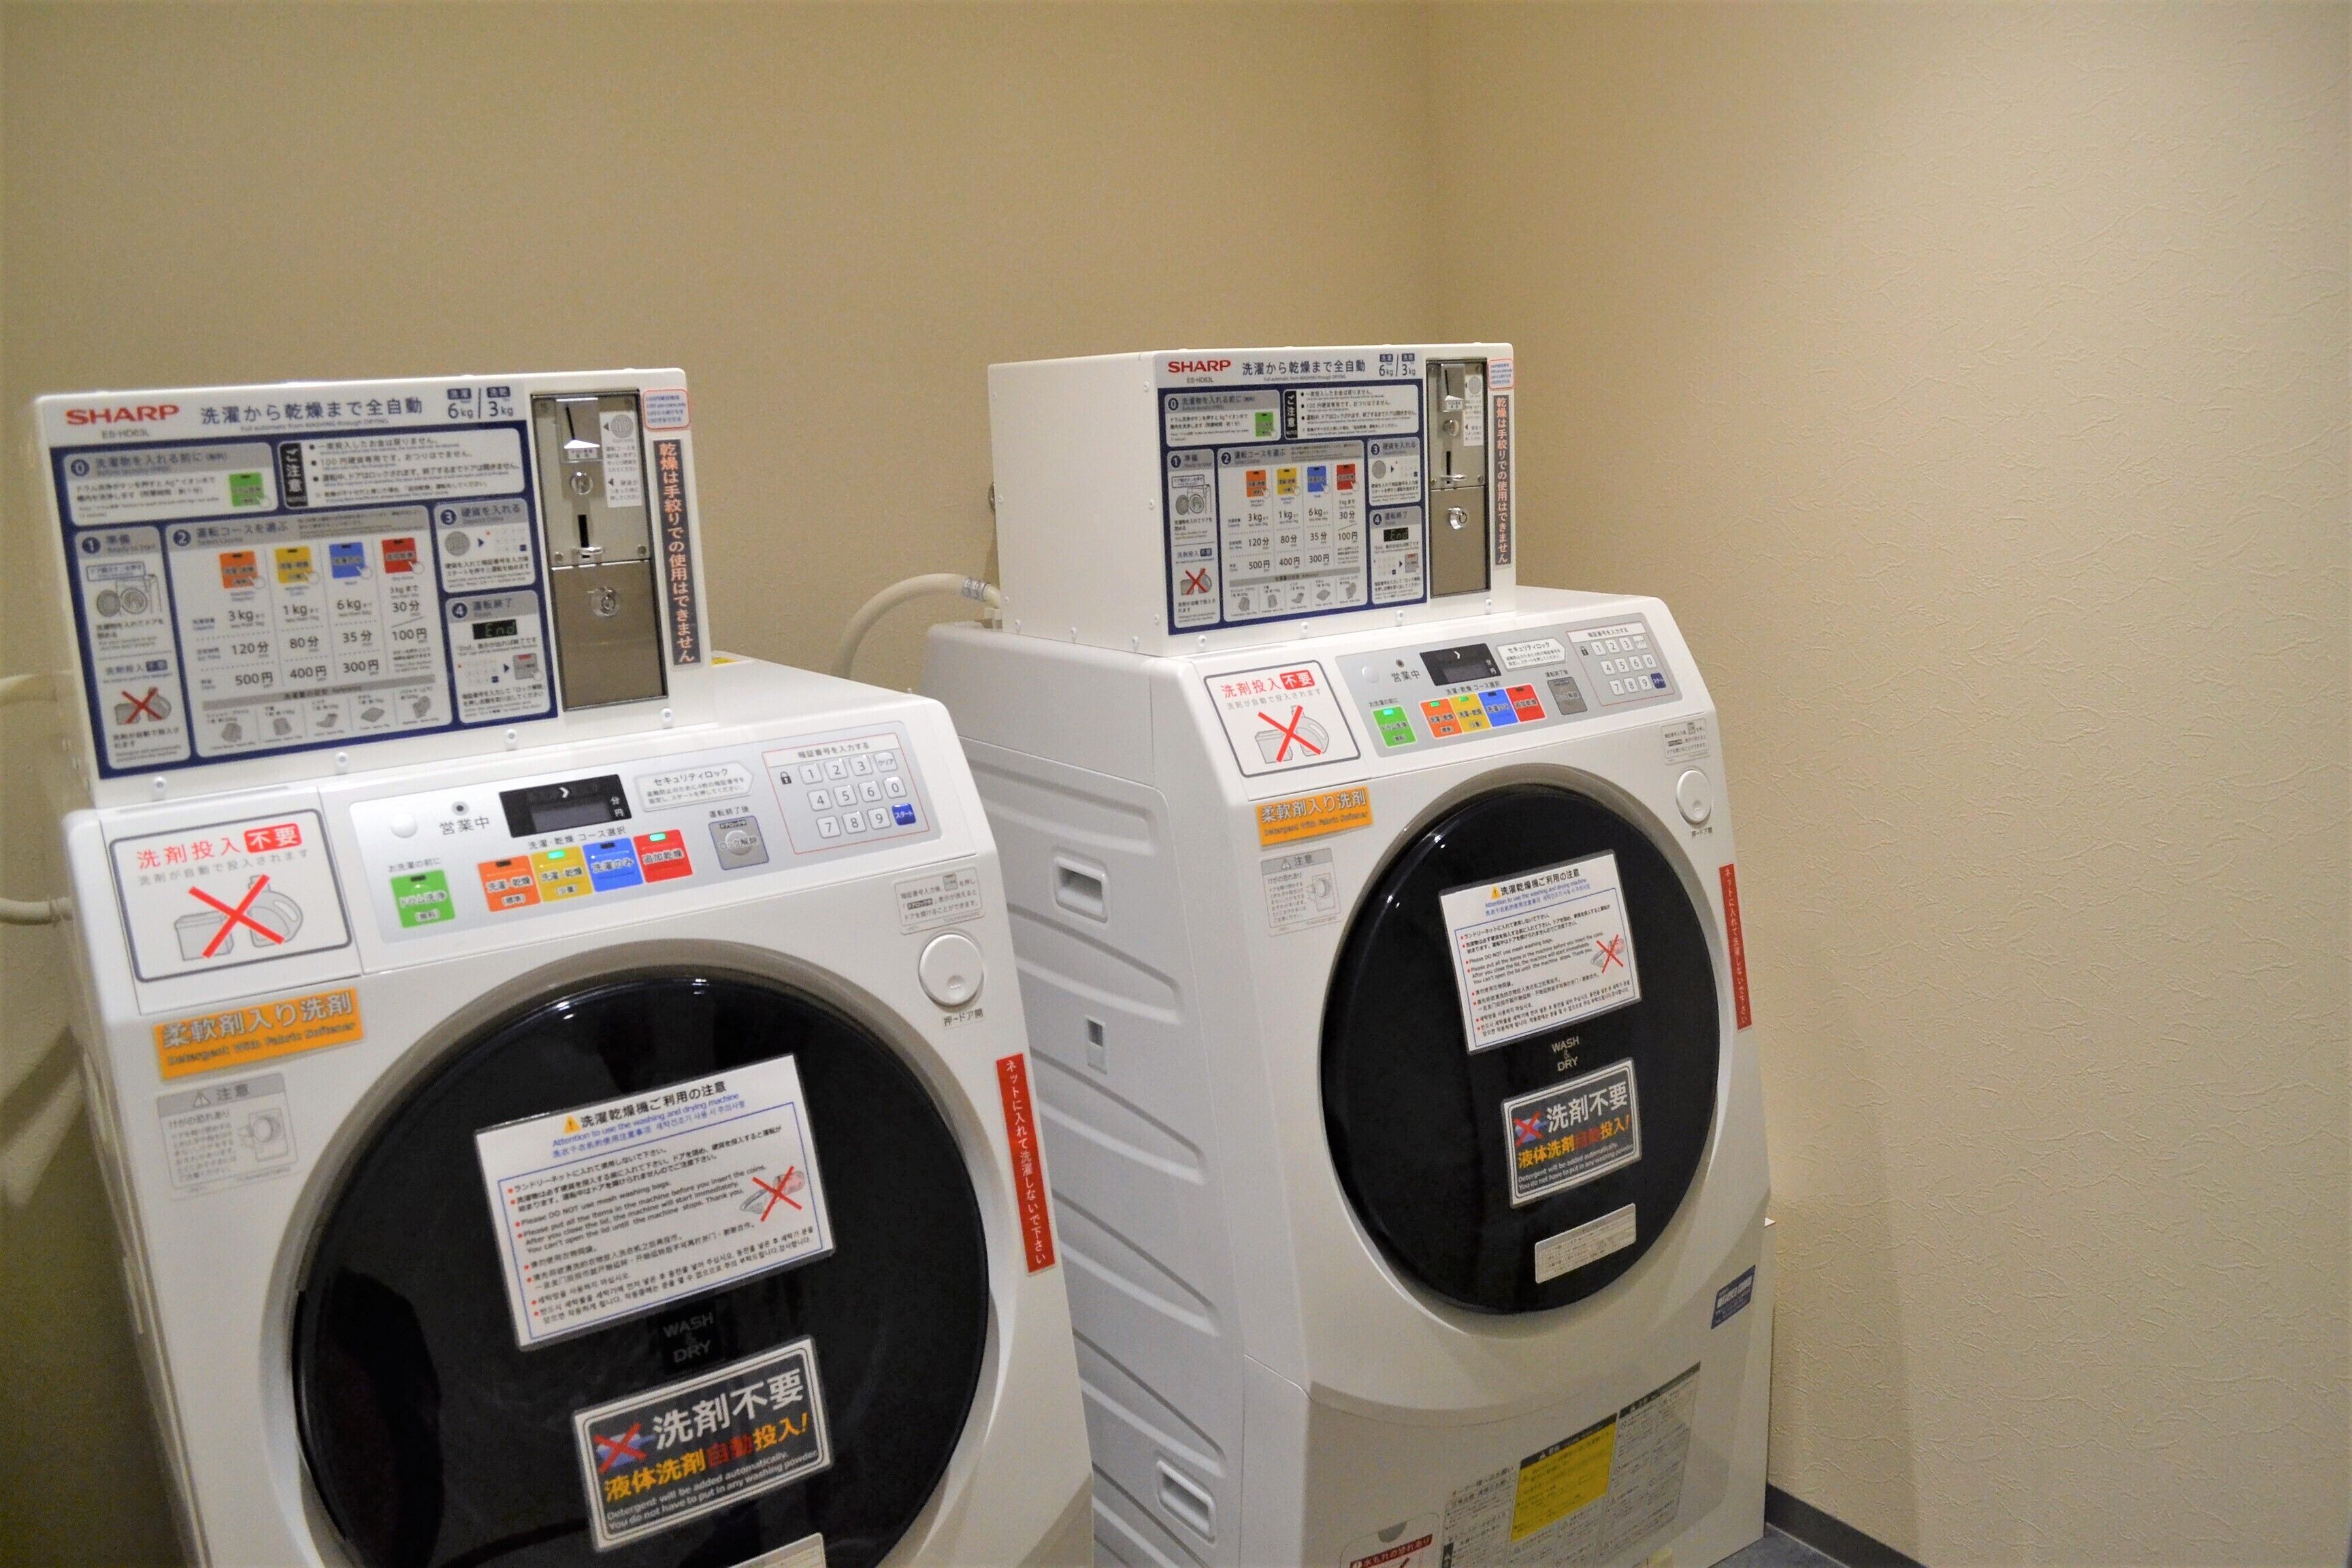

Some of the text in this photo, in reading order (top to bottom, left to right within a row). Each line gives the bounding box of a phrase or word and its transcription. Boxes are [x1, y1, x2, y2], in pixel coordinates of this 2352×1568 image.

[1168, 360, 1230, 373] SHARP
[1242, 359, 1366, 376] 洗濯から乾燥まで全自動
[65, 404, 179, 425] SHARP
[201, 397, 423, 425] 洗濯から乾燥まで全自動
[1497, 397, 1509, 564] 乾燥は手絞りでの使用はできません
[1248, 536, 1269, 547] 120分
[1280, 534, 1297, 544] 80分
[1338, 531, 1358, 541] 100円
[658, 443, 695, 664] 乾燥は手絞りでの使用はできません
[1279, 556, 1301, 566] 400円
[1309, 553, 1330, 564] 300円
[1249, 559, 1270, 570] 500円
[393, 600, 420, 613] 30分
[392, 627, 427, 642] 100円
[1587, 627, 1629, 638] 暗証番号を入力する
[231, 640, 269, 655] 120分
[289, 636, 318, 649] 80分
[1507, 642, 1550, 653] セキュリティロック
[289, 664, 327, 680] 400円
[343, 659, 379, 674] 300円
[235, 671, 273, 687] 500円
[1220, 672, 1314, 698] 洗剤投入 不要
[1391, 670, 1420, 683] 営業中
[1227, 688, 1322, 710] 洗剤が自動で投入されます
[1369, 698, 1399, 707] お洗濯の前に
[797, 741, 870, 760] 暗証番号を入力する
[832, 764, 840, 775] 2
[858, 760, 866, 772] 3
[876, 757, 894, 769] クリア
[652, 766, 729, 787] セキュリティロック
[808, 768, 815, 779] 1
[842, 790, 850, 802] 5
[866, 786, 875, 797] 6
[891, 783, 900, 794] 0
[610, 795, 621, 806] 分
[816, 795, 825, 806] 4
[1261, 788, 1367, 823] 柔軟剤入り洗剤
[614, 807, 625, 819] 円
[708, 805, 749, 819] 運転終了後
[875, 813, 883, 824] 9
[894, 809, 913, 819] スタート
[438, 815, 490, 835] 営業中
[826, 821, 833, 833] 7
[850, 817, 858, 828] 8
[577, 826, 627, 842] コース選択
[137, 825, 299, 870] 洗剤投入 不要
[718, 835, 759, 851] ロック解除
[387, 856, 442, 873] お洗濯の前に
[591, 856, 634, 873] 洗濯のみ
[642, 848, 684, 865] 追加乾燥
[1293, 853, 1313, 866] 注意
[138, 848, 308, 886] 洗剤が自動で投入されます
[1500, 868, 1580, 896] 洗濯乾燥機ご利用の注意
[399, 890, 447, 907] ドラム洗浄
[1484, 877, 1586, 909] Attention washing machine
[1468, 956, 1484, 964] Please
[1524, 941, 1541, 950] washing
[1725, 868, 1748, 1026] ネットに入れて洗濯しないで下さい
[163, 991, 353, 1048] 柔軟剤入り洗剤
[1551, 1036, 1580, 1053] WASH
[1556, 1056, 1579, 1073] DRY
[216, 1083, 249, 1101] 注意
[580, 1080, 728, 1128] 洗濯乾燥機ご利用の注意
[1546, 1081, 1628, 1133] 洗剤不要
[552, 1091, 739, 1147] Attention the washing and drying machine
[1006, 1060, 1046, 1266] ネットに入れて洗濯しないで下さい
[520, 1186, 651, 1226] Please DO NOT mesh washing
[523, 1164, 766, 1237] Please put the items the machine before insert the coins.
[525, 1194, 692, 1245] After close the the machine will start
[527, 1192, 728, 1254] You open the until the machine Thank
[662, 1311, 715, 1339] WASH
[673, 1339, 713, 1363] DRY
[653, 1368, 804, 1450] 洗剤不要
[604, 1411, 809, 1503] 液体洗剤自動投入!
[660, 1463, 783, 1513] have washing
[605, 1497, 658, 1521] Detergent
[657, 1489, 677, 1503] will
[691, 1473, 723, 1490] added
